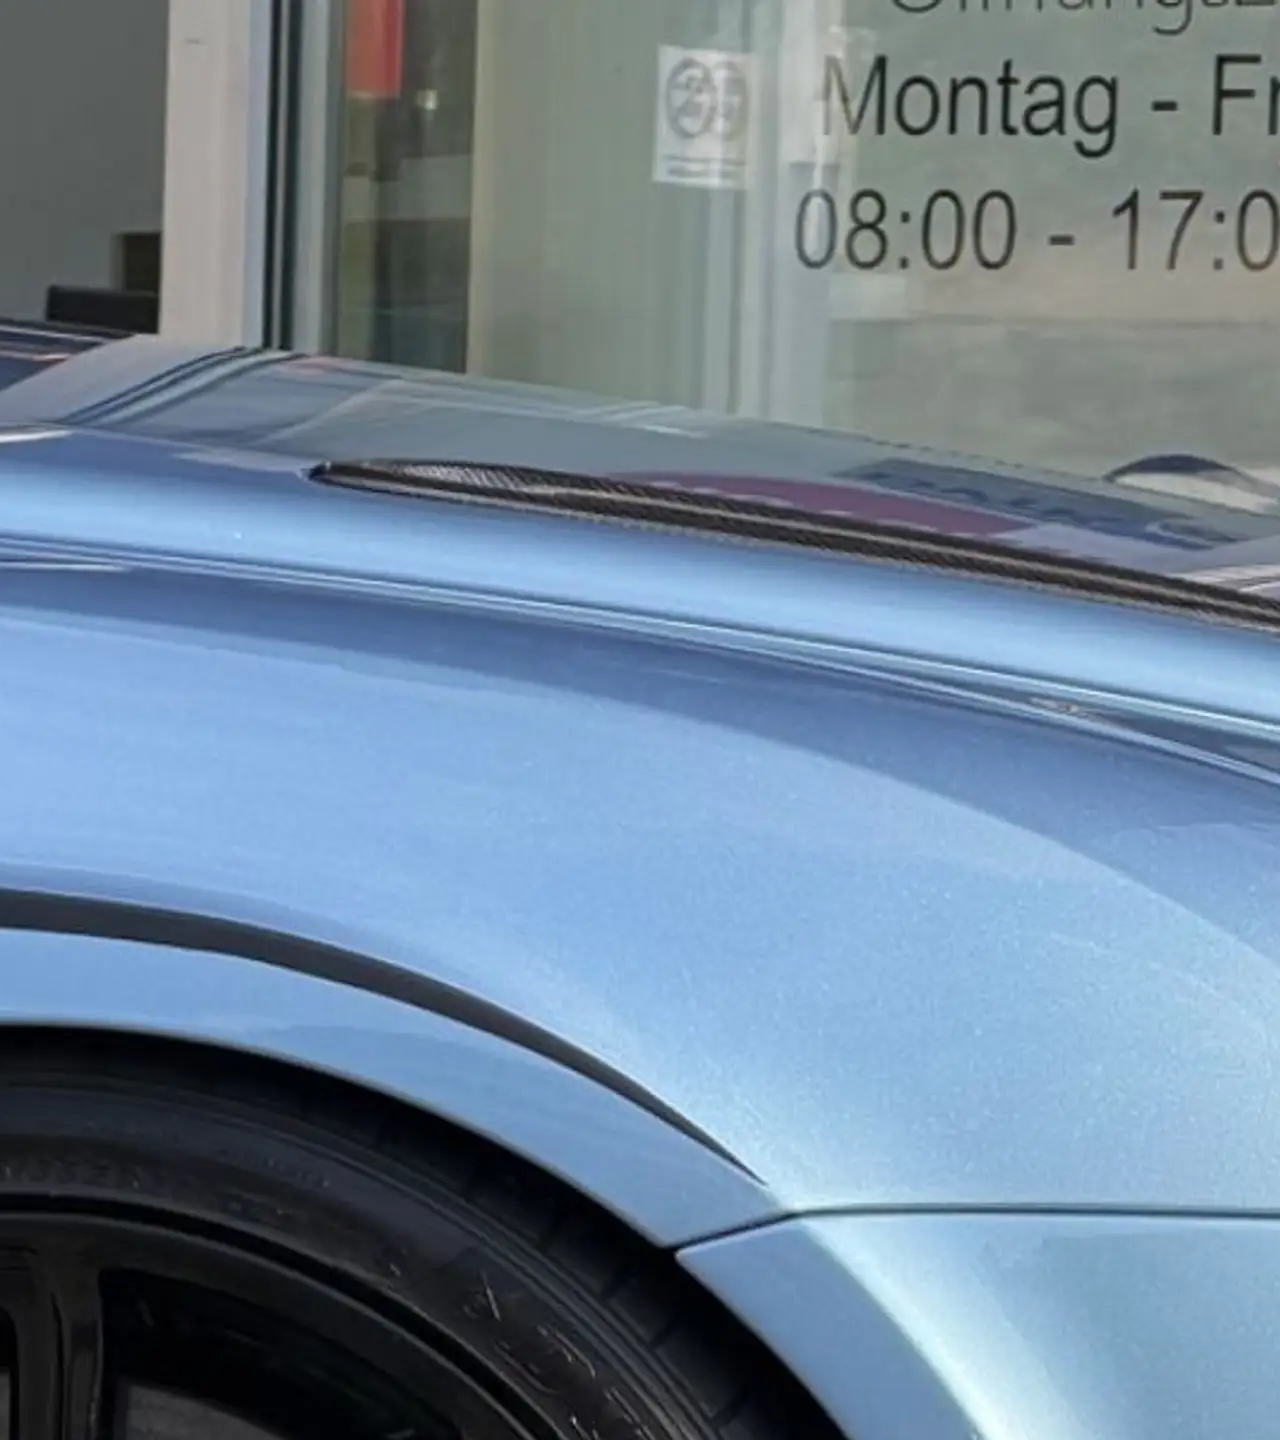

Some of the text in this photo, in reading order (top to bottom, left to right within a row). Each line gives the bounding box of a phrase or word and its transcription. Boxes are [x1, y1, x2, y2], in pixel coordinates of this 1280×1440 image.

[821, 54, 1118, 158] Montag
[1151, 99, 1179, 112] -
[794, 188, 1017, 271] 08:00
[1047, 233, 1075, 246] -
